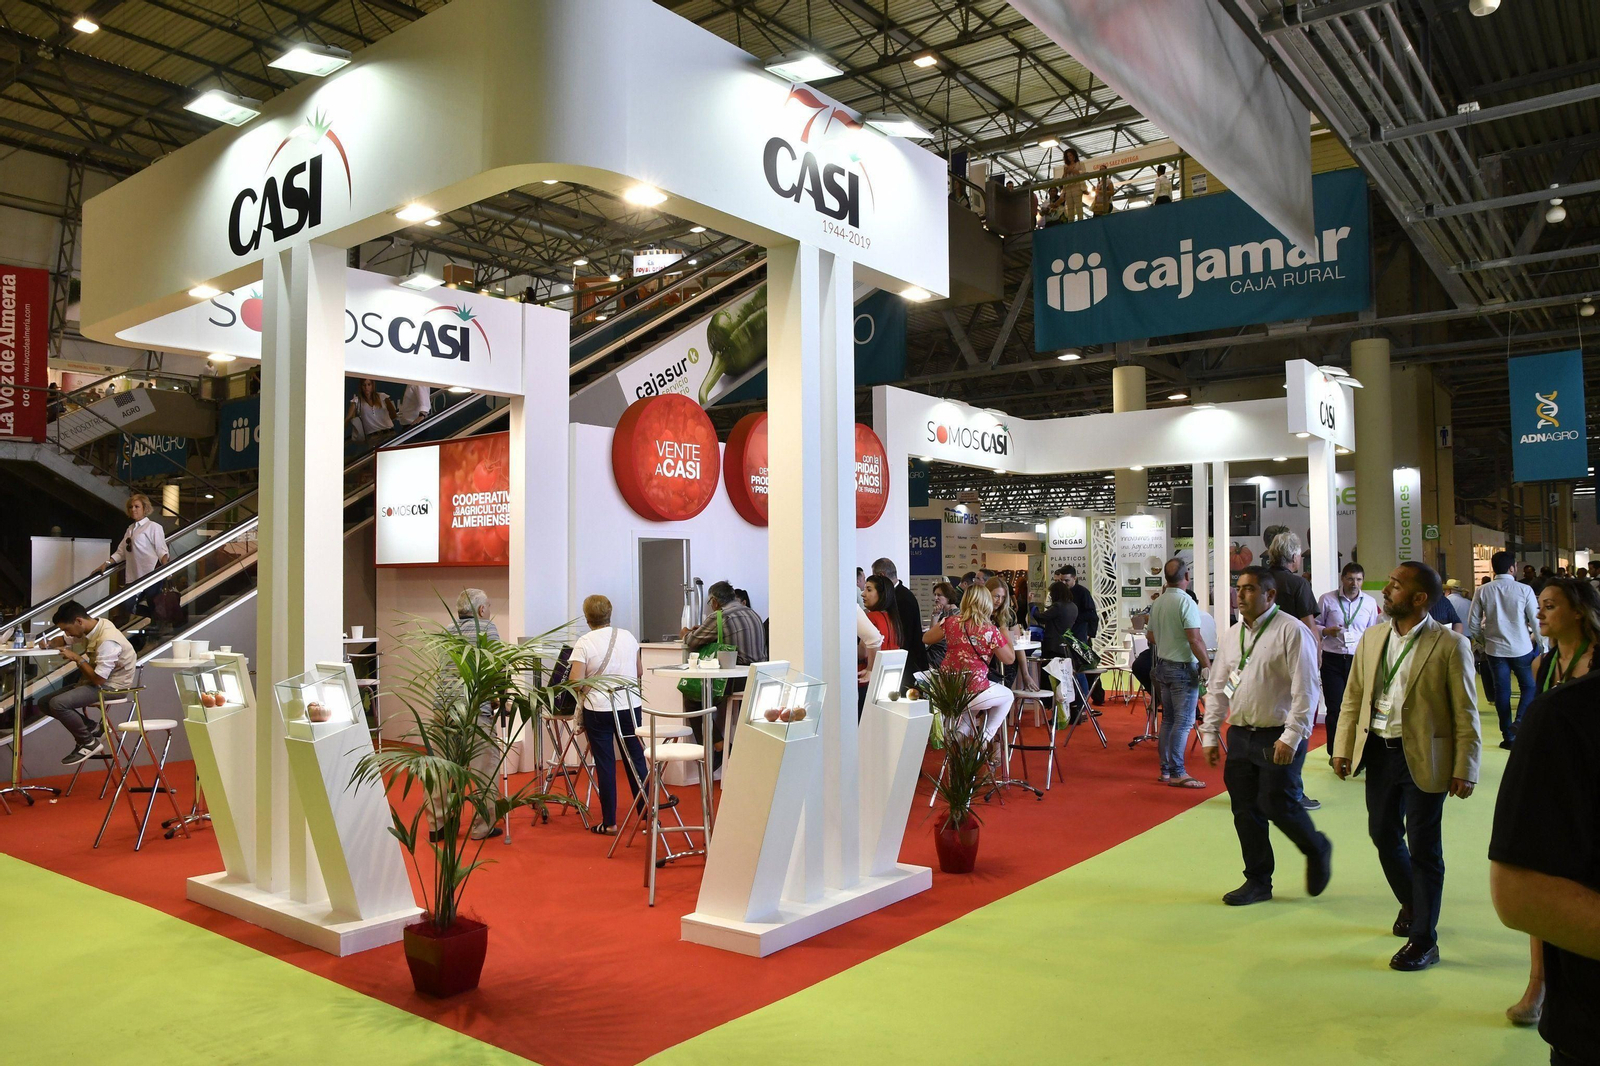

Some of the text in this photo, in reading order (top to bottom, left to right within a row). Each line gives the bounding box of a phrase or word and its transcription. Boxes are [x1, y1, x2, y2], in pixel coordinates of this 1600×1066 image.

[1121, 155, 1140, 164] ORTEGA
[763, 136, 860, 229] CASI
[228, 153, 323, 257] CASI
[823, 219, 871, 249] 1944-2019
[1122, 226, 1350, 299] cajamar
[1230, 264, 1346, 295] CAJA RURAL
[1, 350, 15, 373] de
[0, 376, 14, 409] Voz
[636, 357, 687, 399] cajasur
[0, 412, 14, 435] La
[122, 405, 140, 418] AGRO
[1320, 401, 1336, 430] CASI
[656, 440, 701, 461] VENTE
[1520, 430, 1579, 444] ADNAGRO
[1399, 484, 1411, 561] filosem.es
